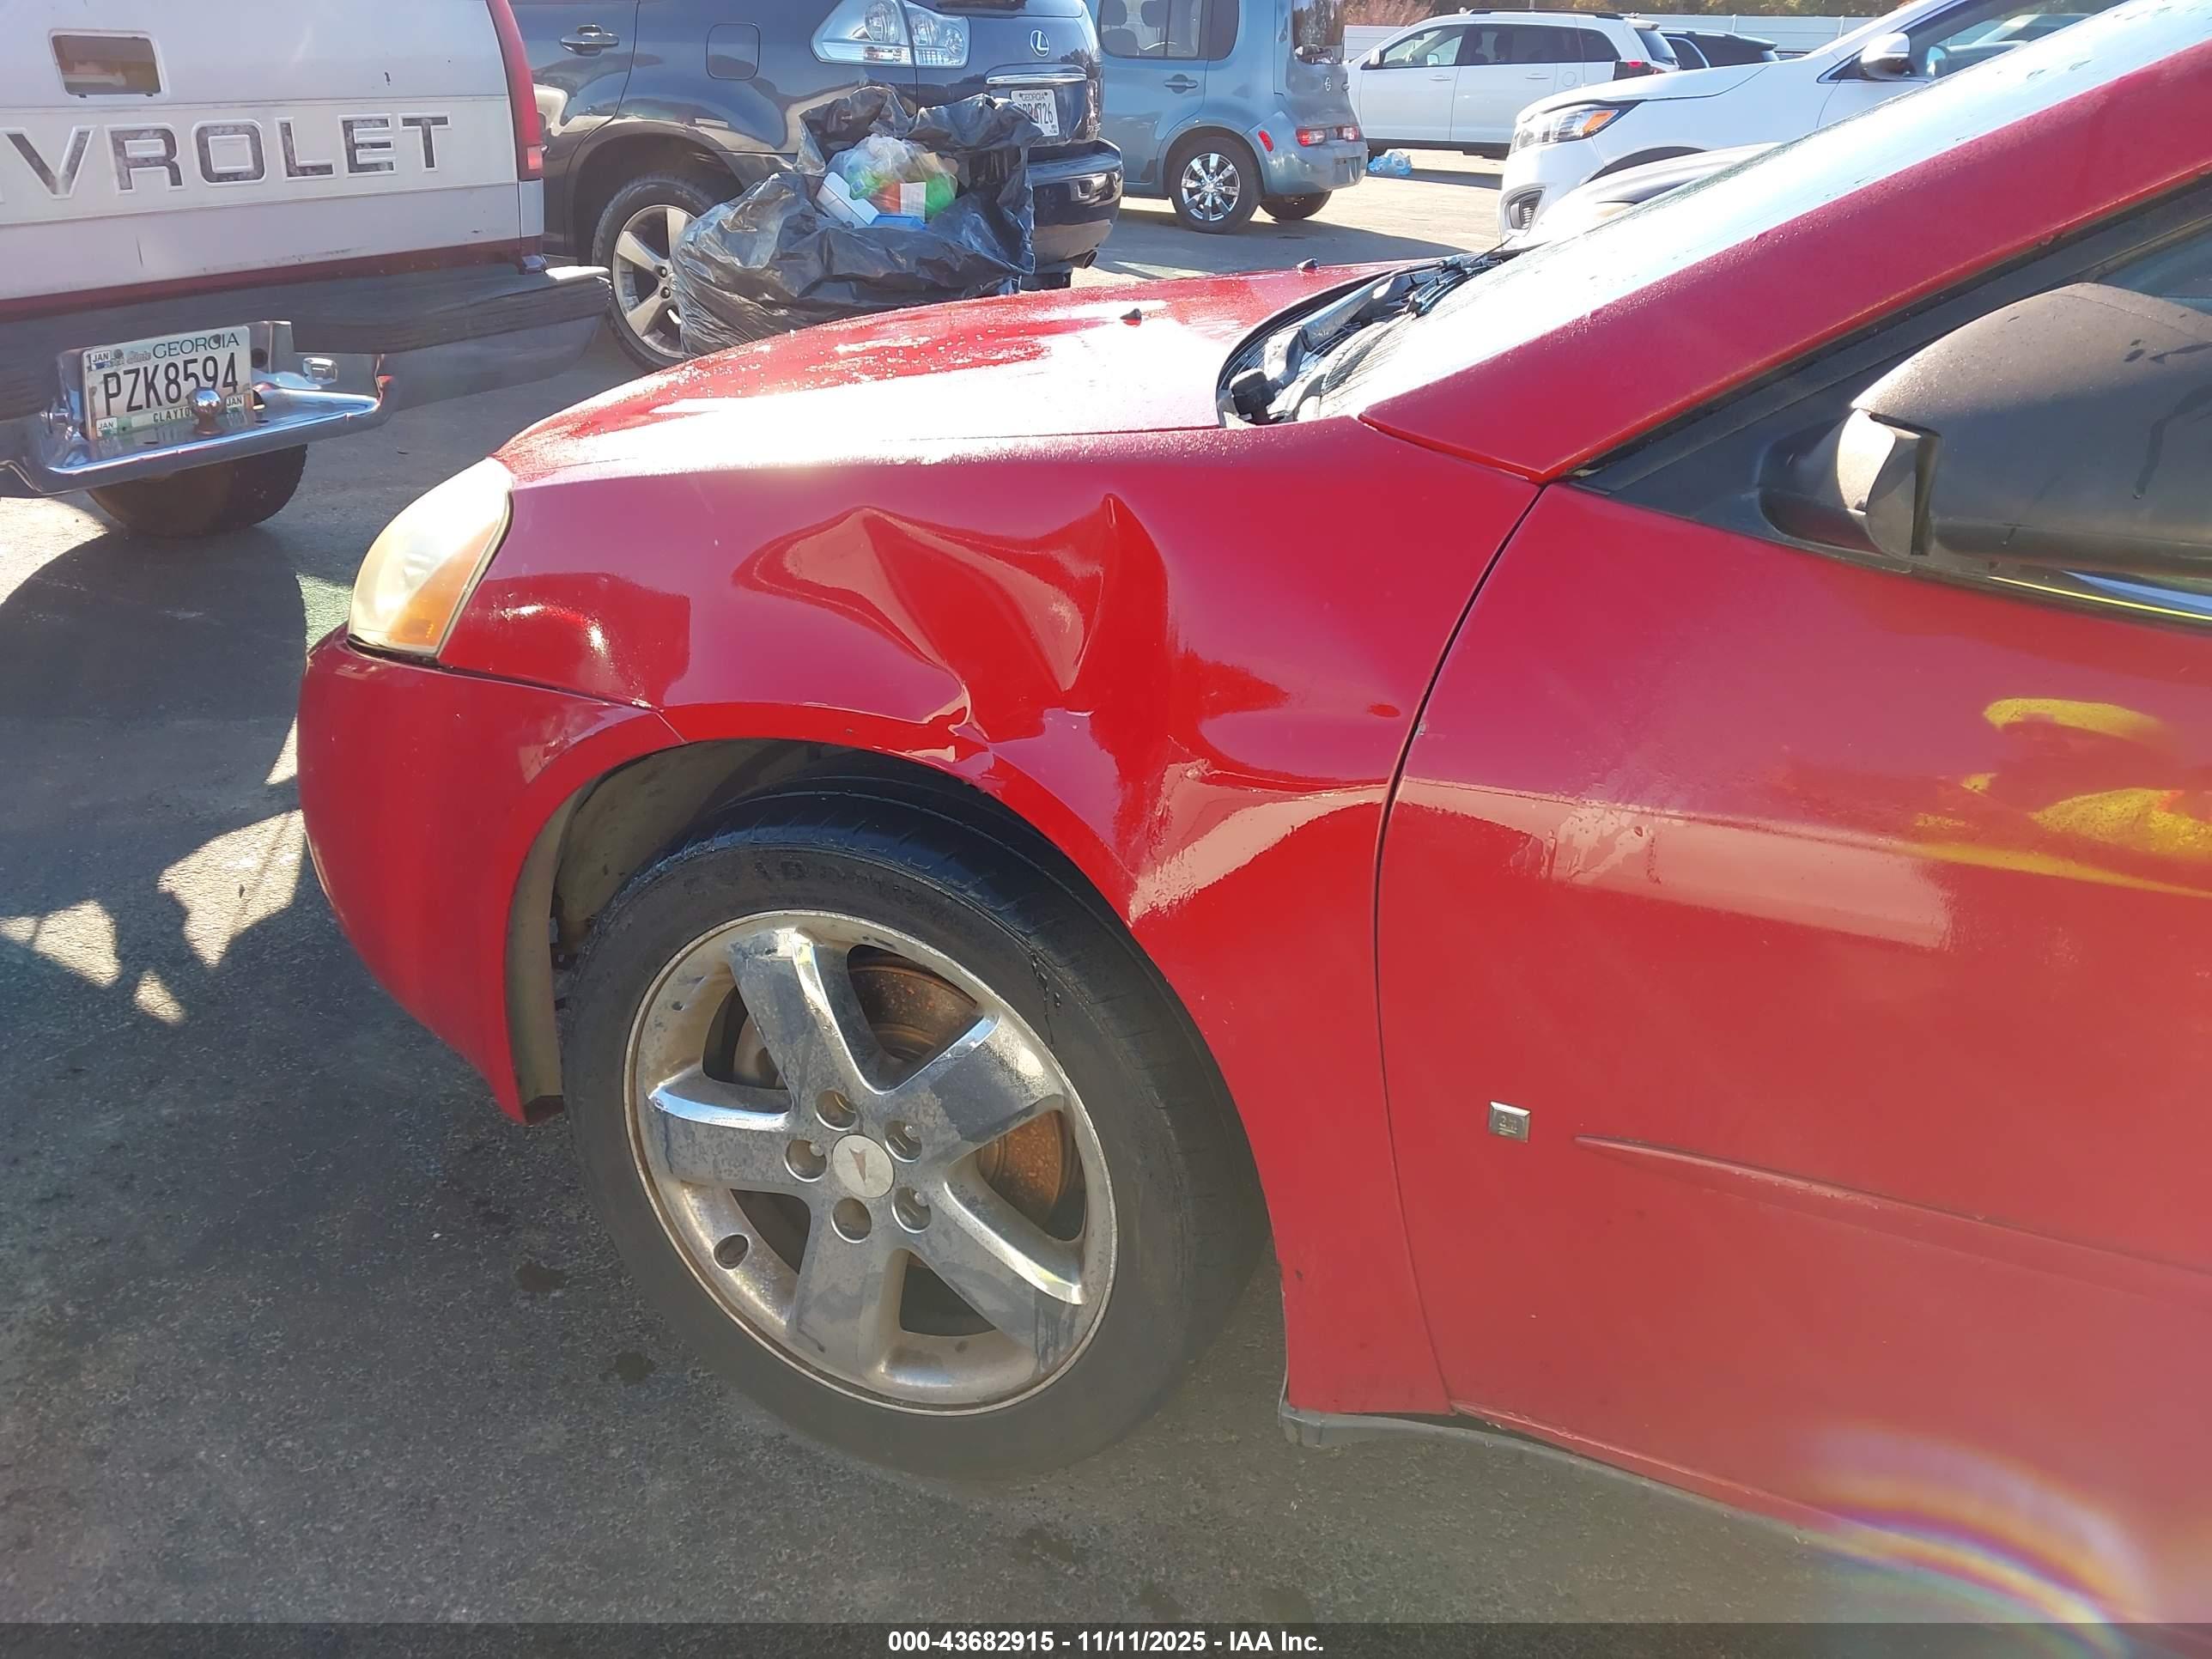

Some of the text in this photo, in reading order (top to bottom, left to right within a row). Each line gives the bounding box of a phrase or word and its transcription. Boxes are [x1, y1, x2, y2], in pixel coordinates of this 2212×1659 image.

[153, 332, 240, 359] GEORGIA
[92, 352, 109, 363] JAN
[102, 352, 239, 416] PZK8594
[226, 397, 242, 407] JAN
[98, 422, 114, 430] JAN
